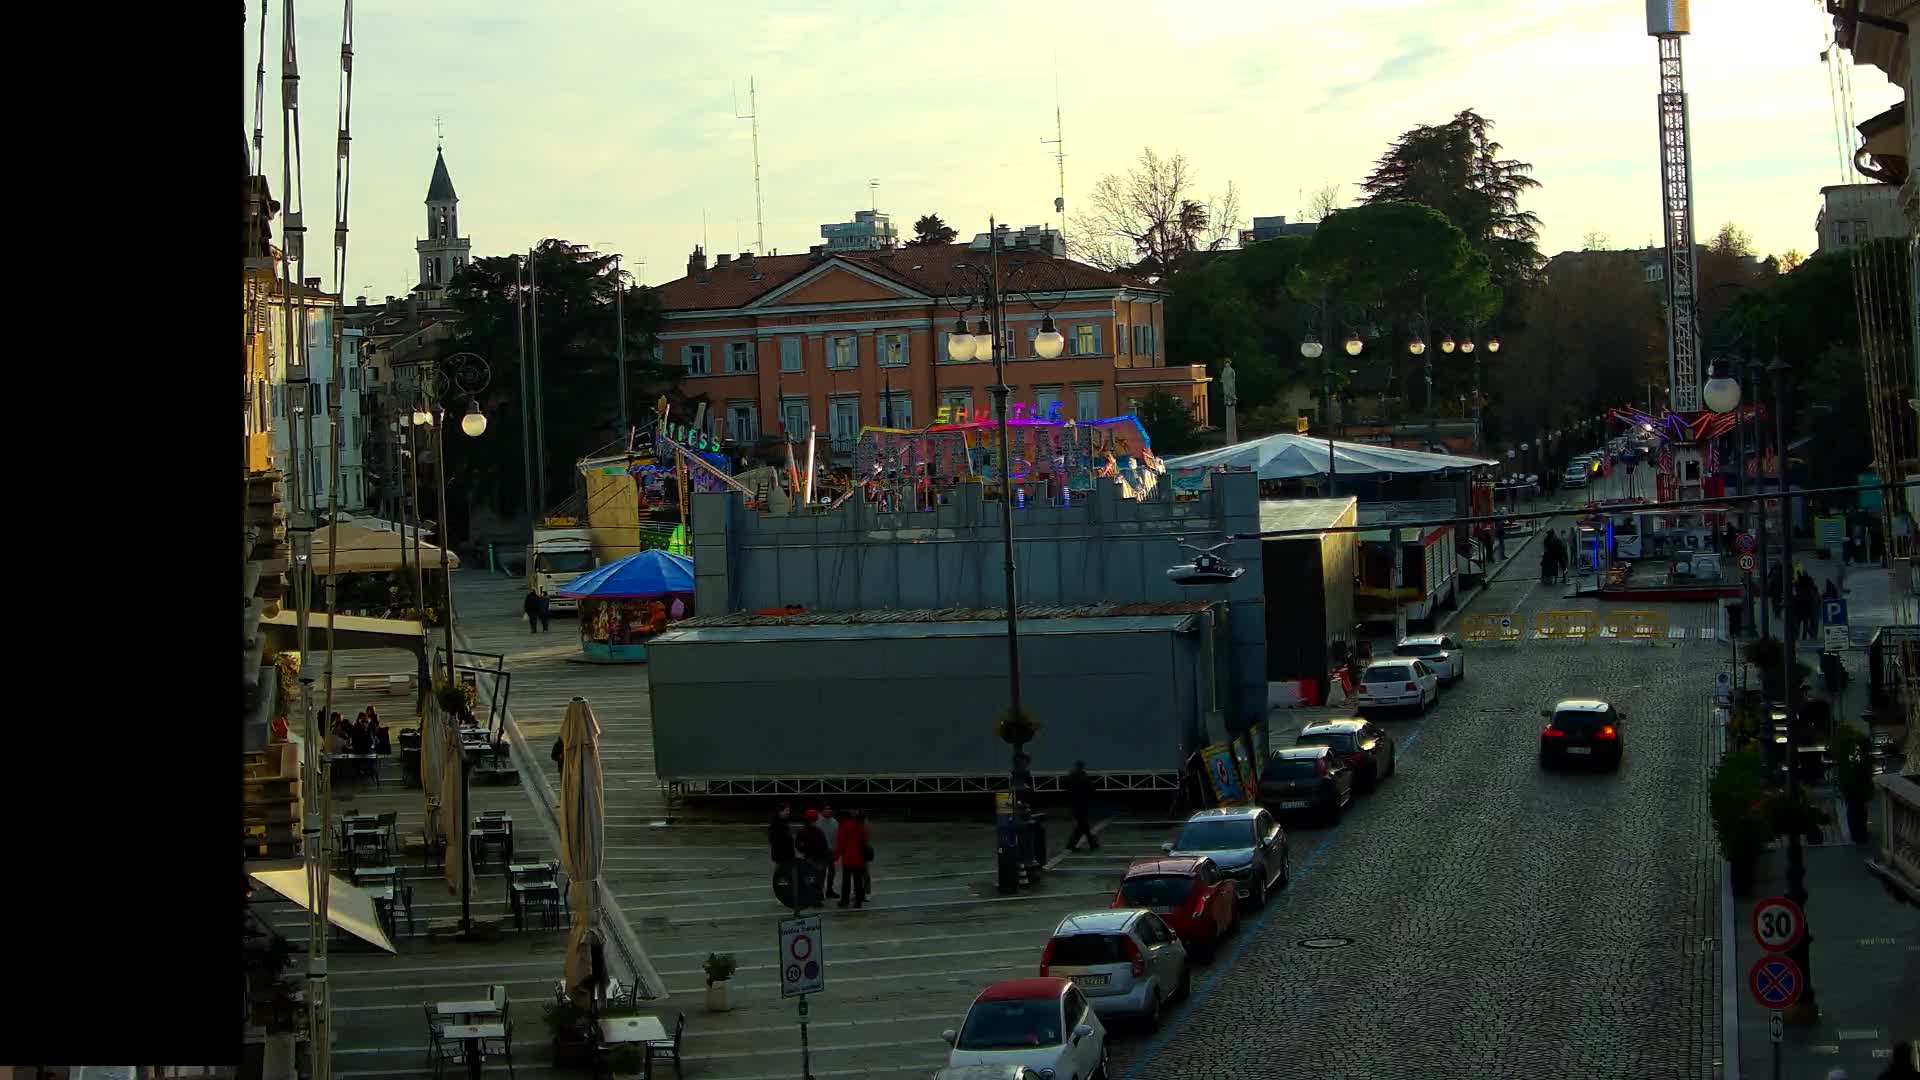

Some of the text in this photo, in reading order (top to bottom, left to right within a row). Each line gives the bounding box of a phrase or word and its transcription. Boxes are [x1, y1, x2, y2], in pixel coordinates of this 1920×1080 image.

[936, 401, 1065, 424] SHUTLE
[1827, 602, 1841, 623] P
[1761, 911, 1791, 938] 30
